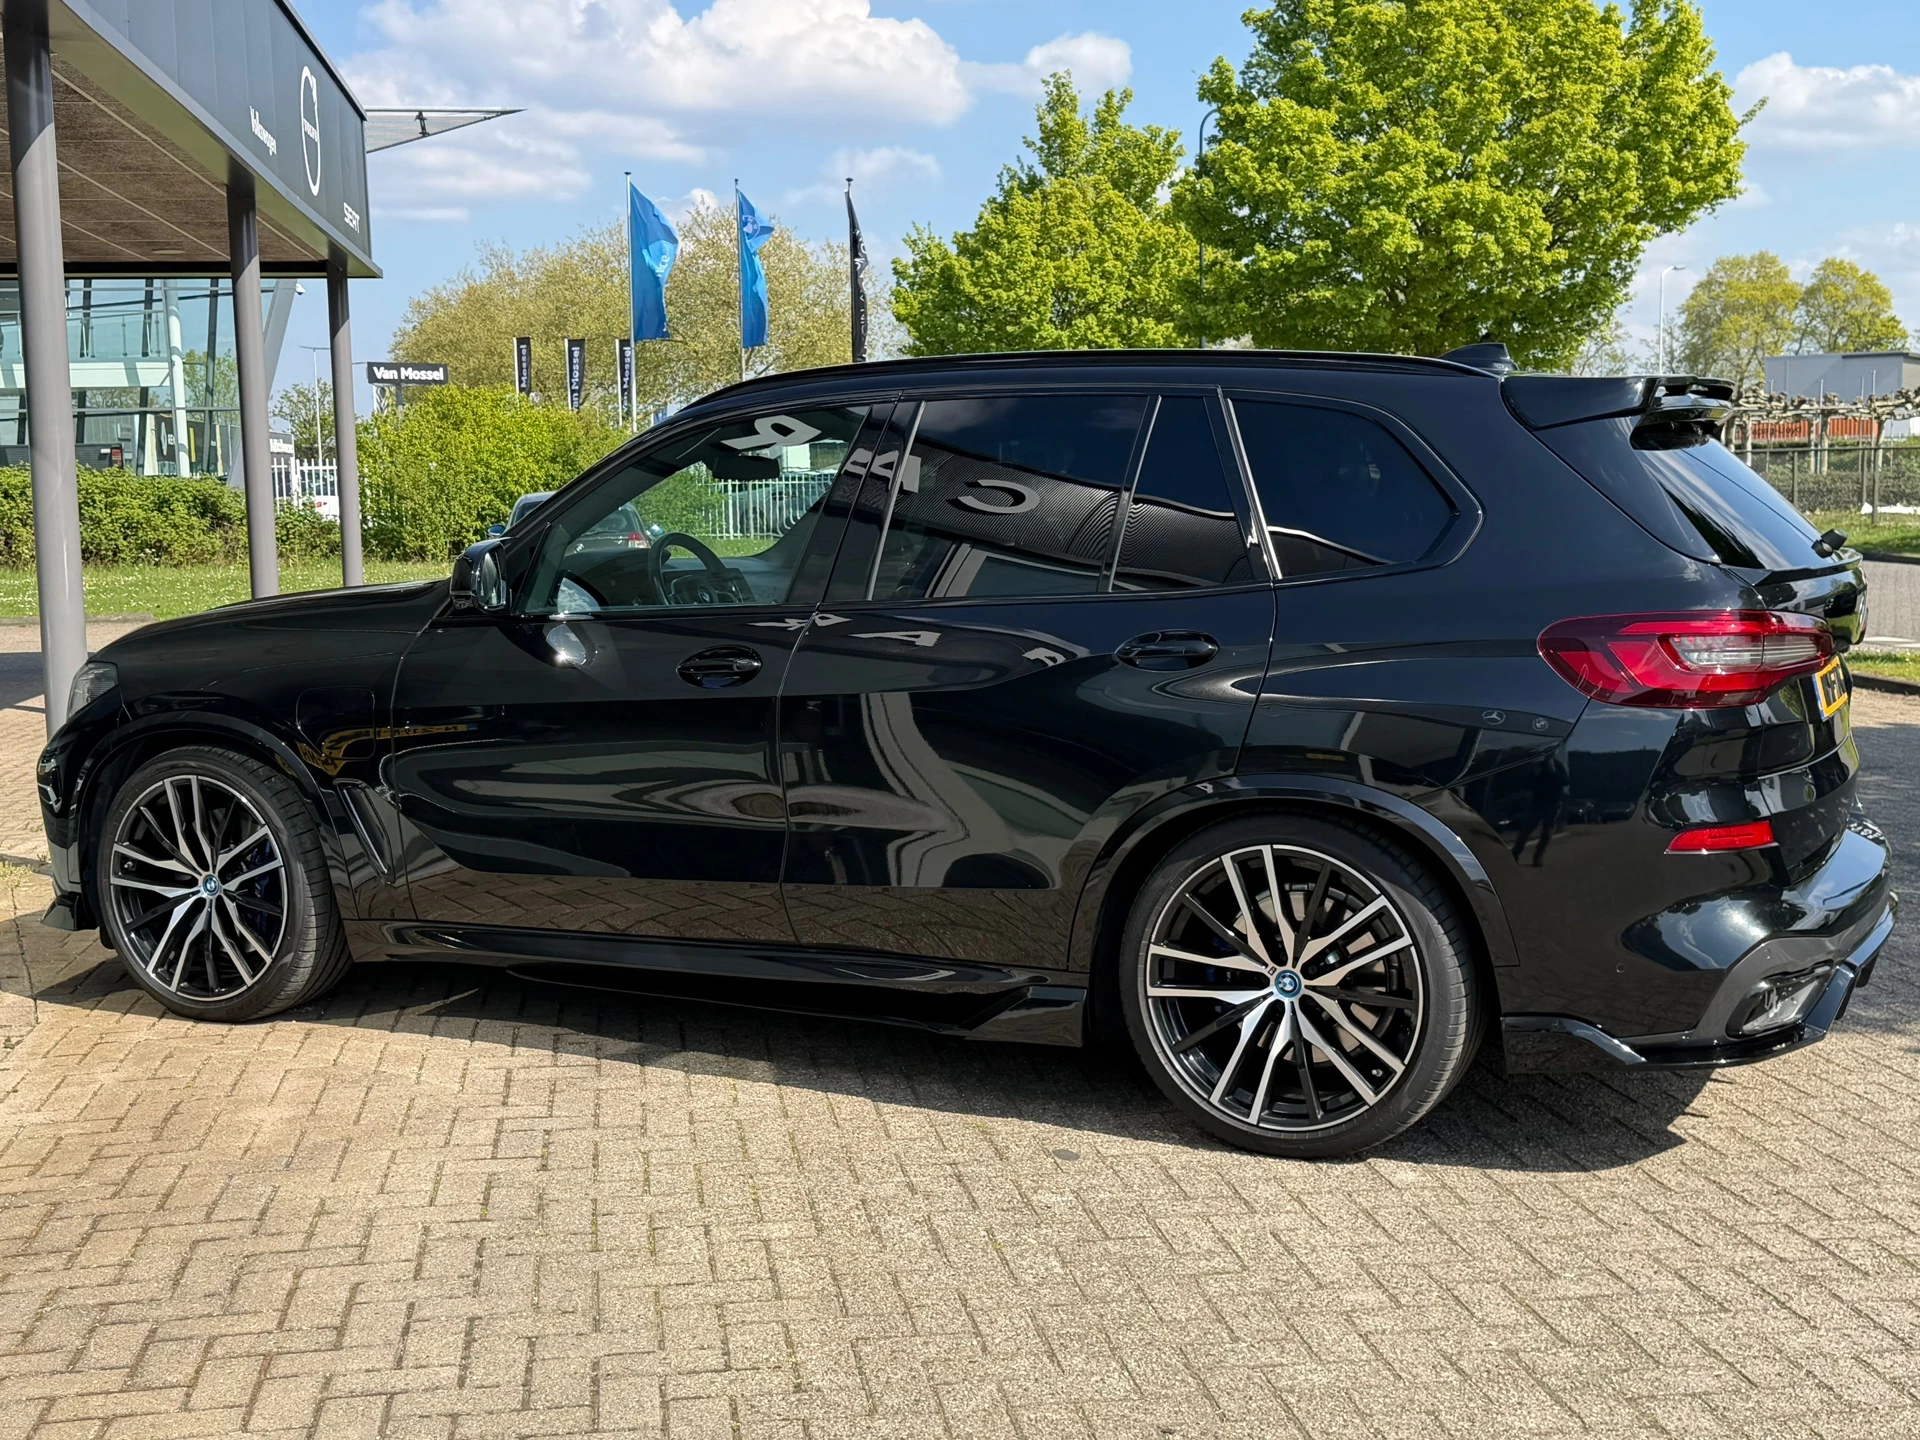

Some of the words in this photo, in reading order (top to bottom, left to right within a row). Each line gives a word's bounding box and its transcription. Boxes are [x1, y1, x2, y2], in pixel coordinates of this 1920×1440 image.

[343, 202, 360, 233] SEAT
[373, 366, 398, 380] Van
[400, 366, 444, 381] Mossel
[519, 344, 528, 389] Mossel
[571, 346, 580, 390] Mossel
[622, 346, 631, 389] Mossel
